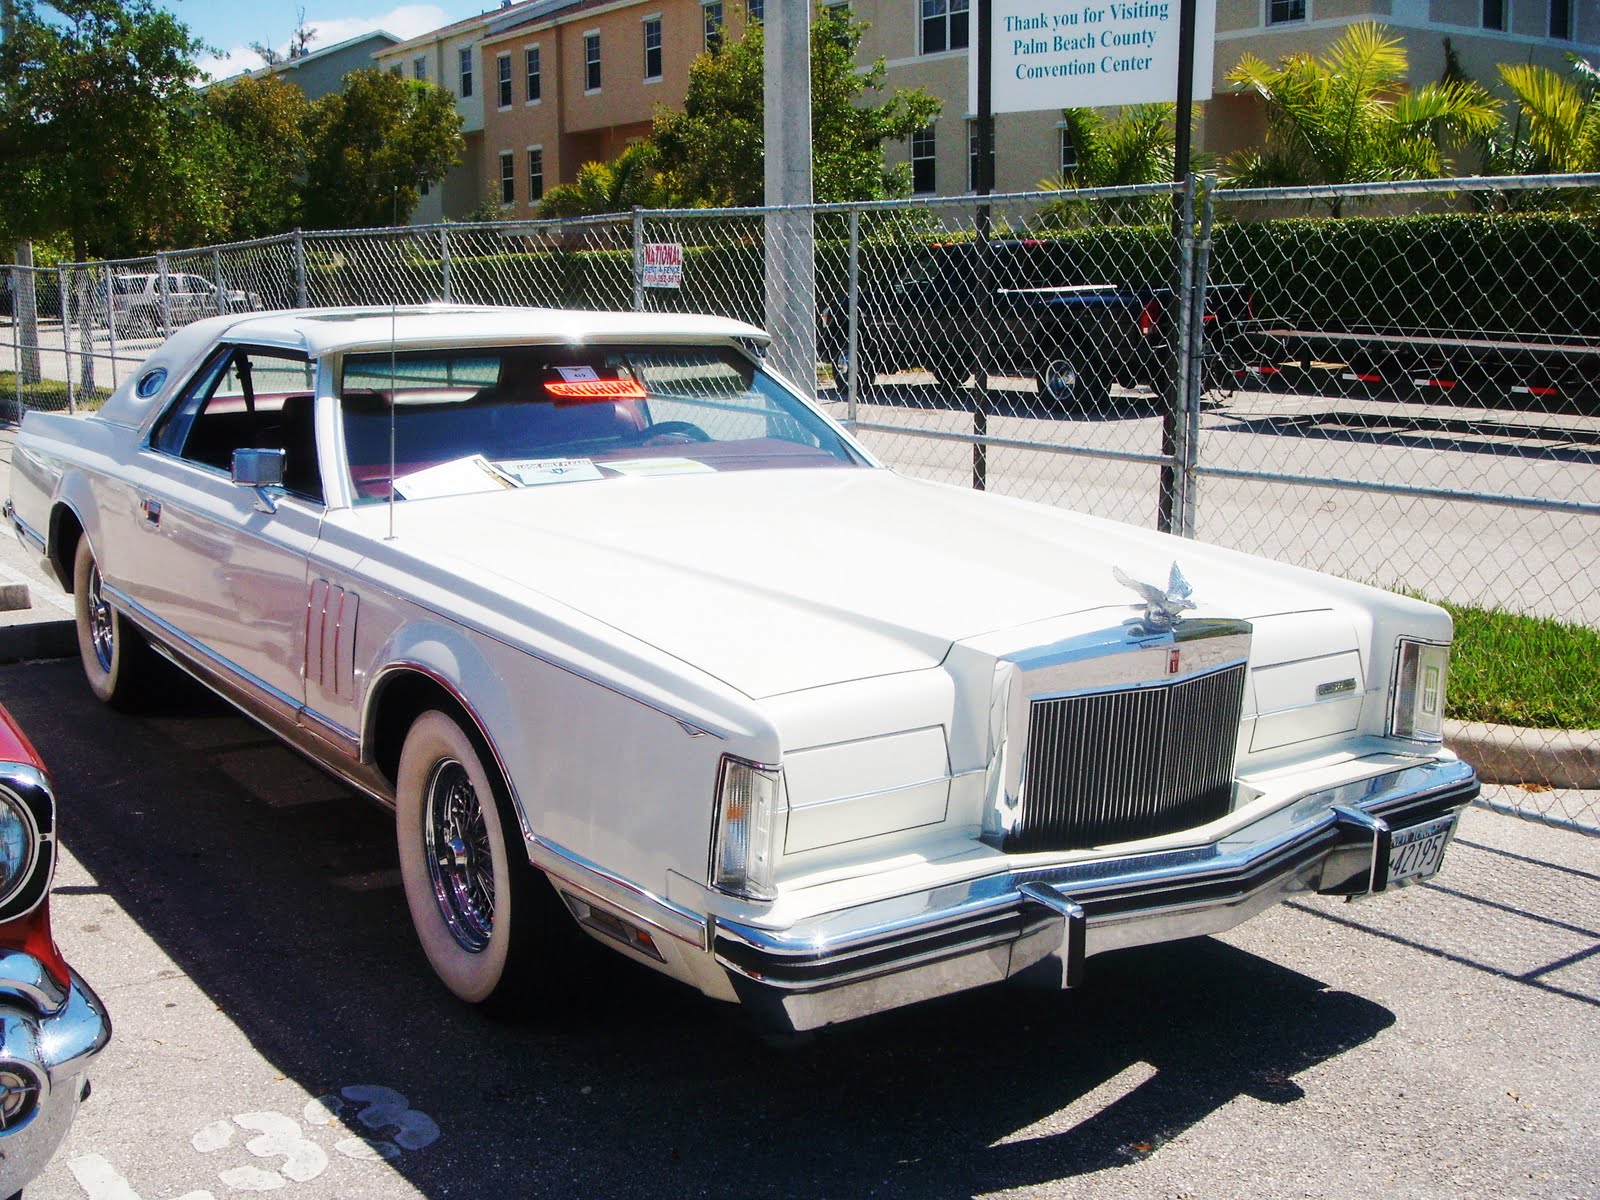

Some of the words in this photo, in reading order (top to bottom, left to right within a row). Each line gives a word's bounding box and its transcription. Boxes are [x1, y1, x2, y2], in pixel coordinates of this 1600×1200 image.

[1004, 13, 1049, 32] Thank
[1053, 14, 1078, 31] you
[1083, 7, 1105, 24] for
[1110, 1, 1169, 21] Visiting
[1013, 38, 1048, 56] Palm
[1053, 33, 1095, 52] Beach
[1100, 29, 1157, 48] County
[1015, 59, 1096, 80] Convention
[1100, 56, 1153, 73] Center
[645, 245, 681, 265] NATIONAL
[552, 381, 638, 395] SATURDAY
